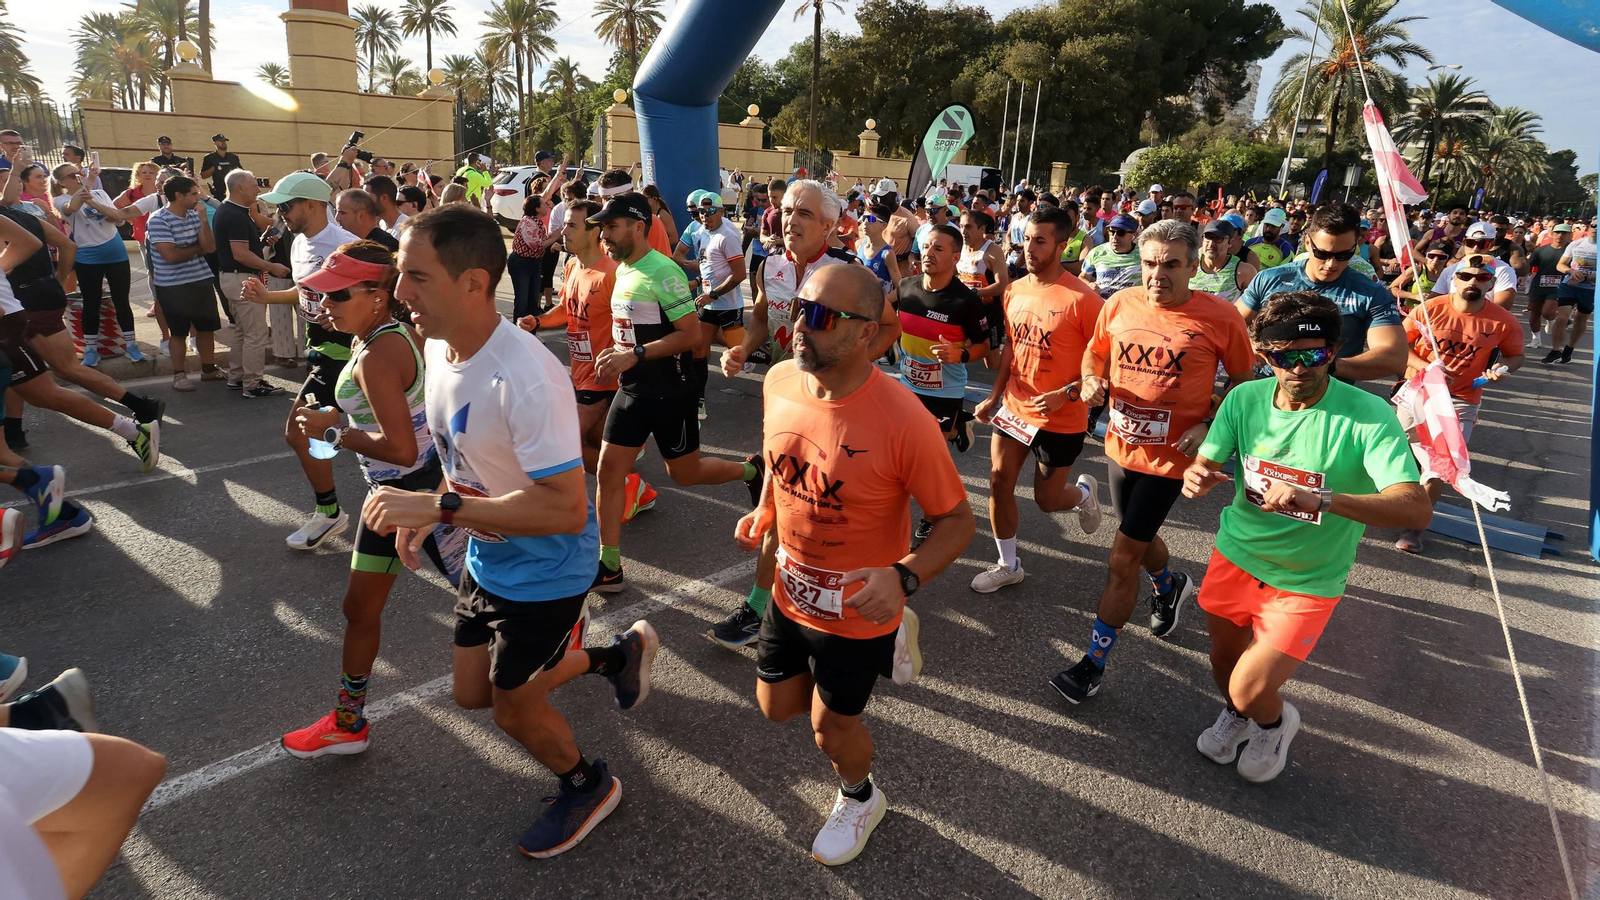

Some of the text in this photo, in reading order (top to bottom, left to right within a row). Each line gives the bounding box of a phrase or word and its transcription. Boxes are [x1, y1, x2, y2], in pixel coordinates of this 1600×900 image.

[935, 139, 960, 147] SPORT
[926, 309, 949, 323] 226ERS
[1298, 323, 1321, 332] FILA
[910, 370, 932, 381] 547
[1007, 414, 1028, 430] 348
[1121, 416, 1152, 436] 374
[786, 573, 822, 605] 527
